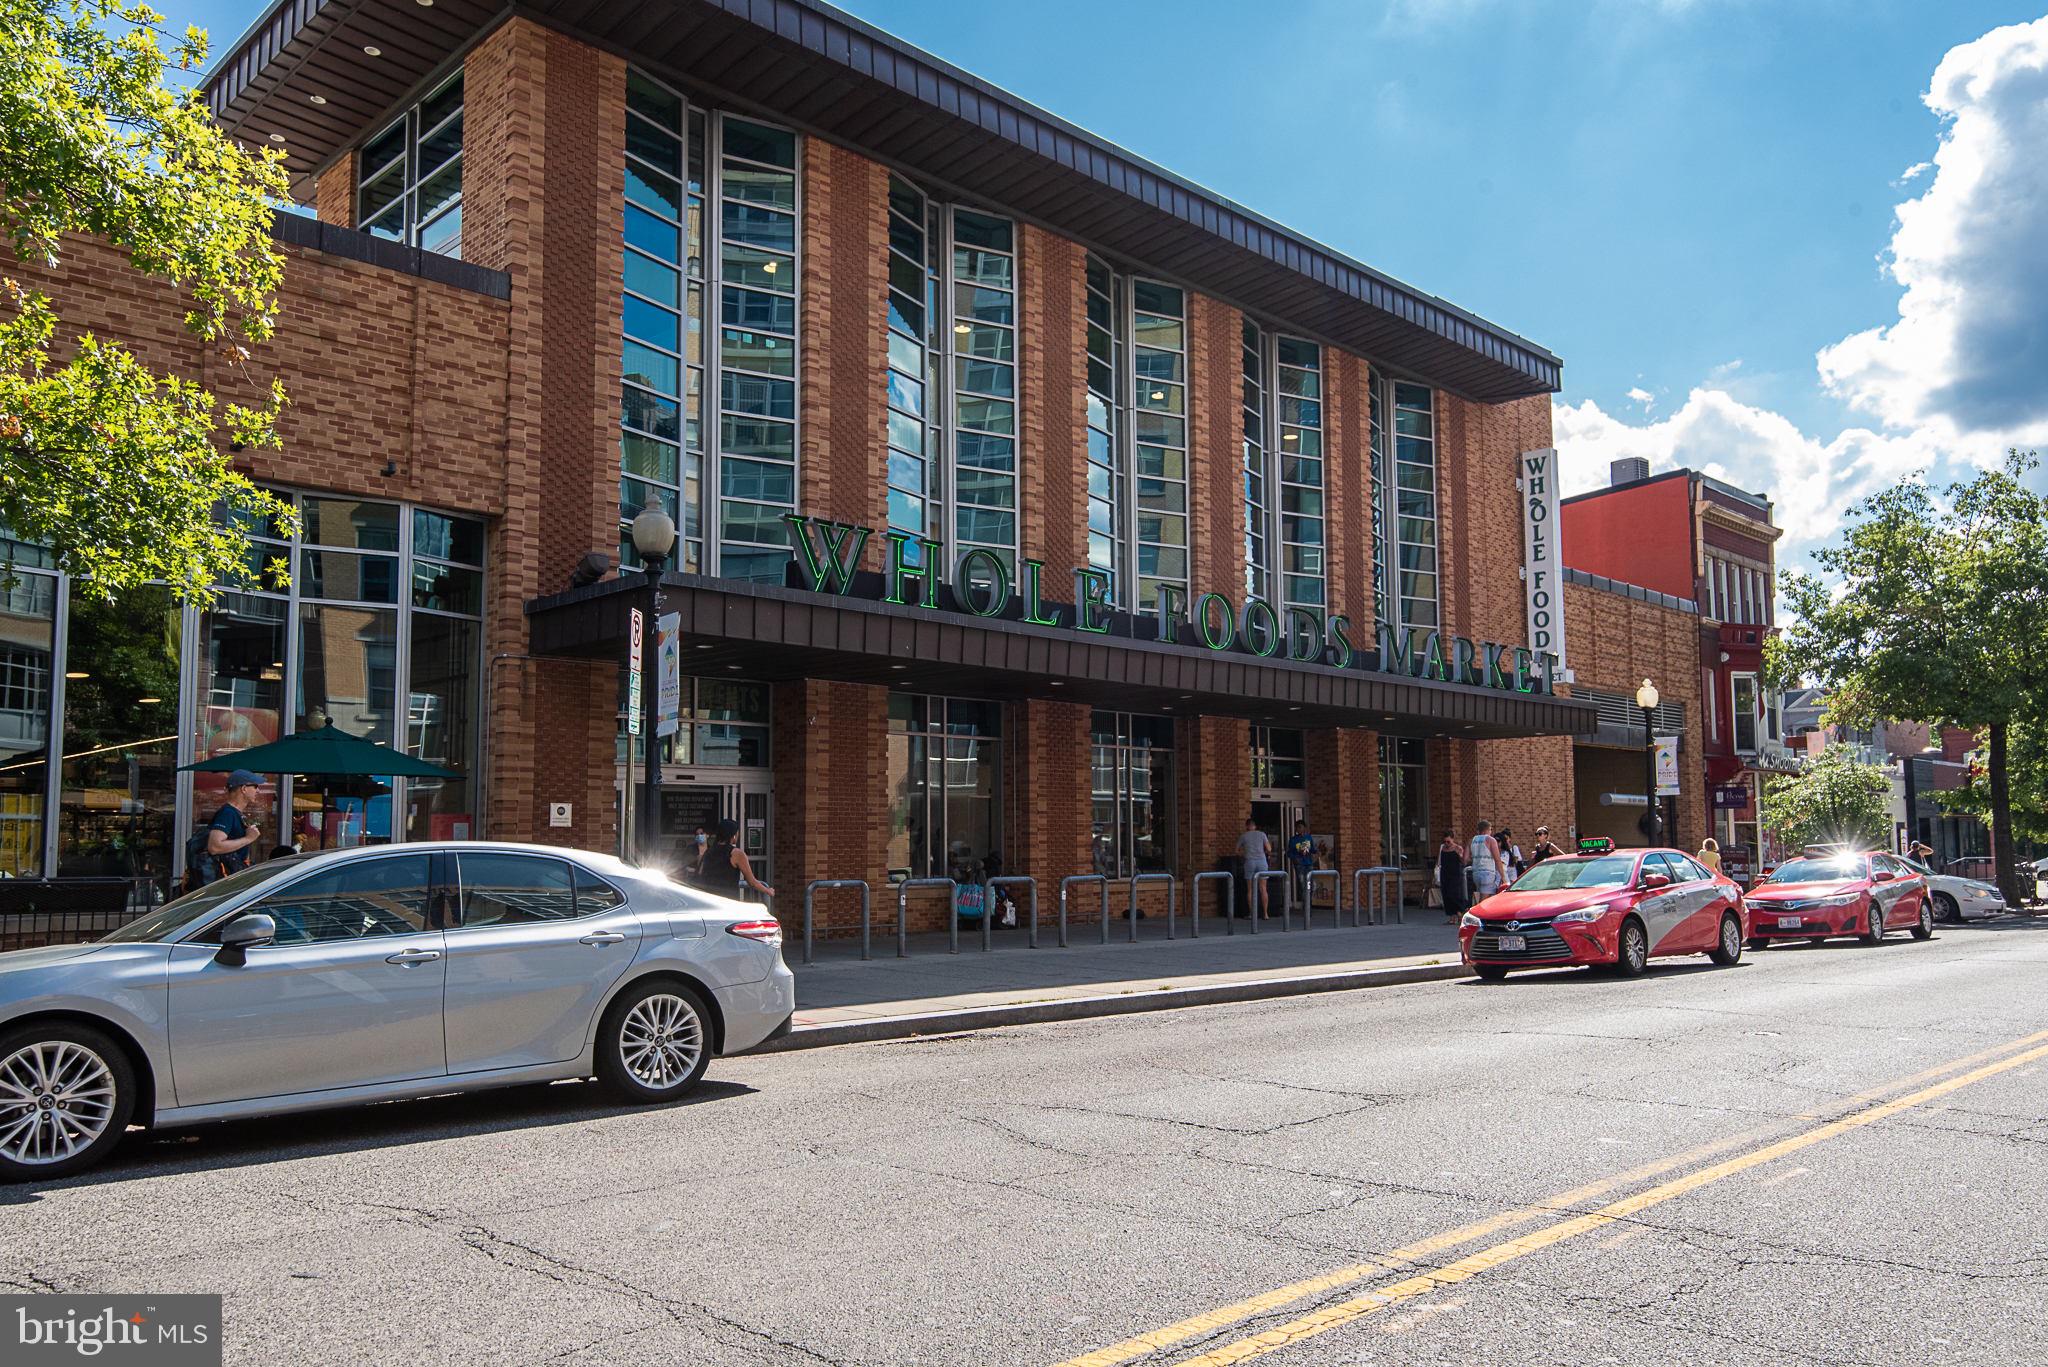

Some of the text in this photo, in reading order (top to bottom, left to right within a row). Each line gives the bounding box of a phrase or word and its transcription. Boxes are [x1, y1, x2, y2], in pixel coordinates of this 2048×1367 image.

[1525, 455, 1547, 562] WHOLE
[781, 513, 1559, 697] WHOLE FOODS MARKET
[1532, 571, 1550, 667] FOOD
[1580, 839, 1607, 848] VACANT
